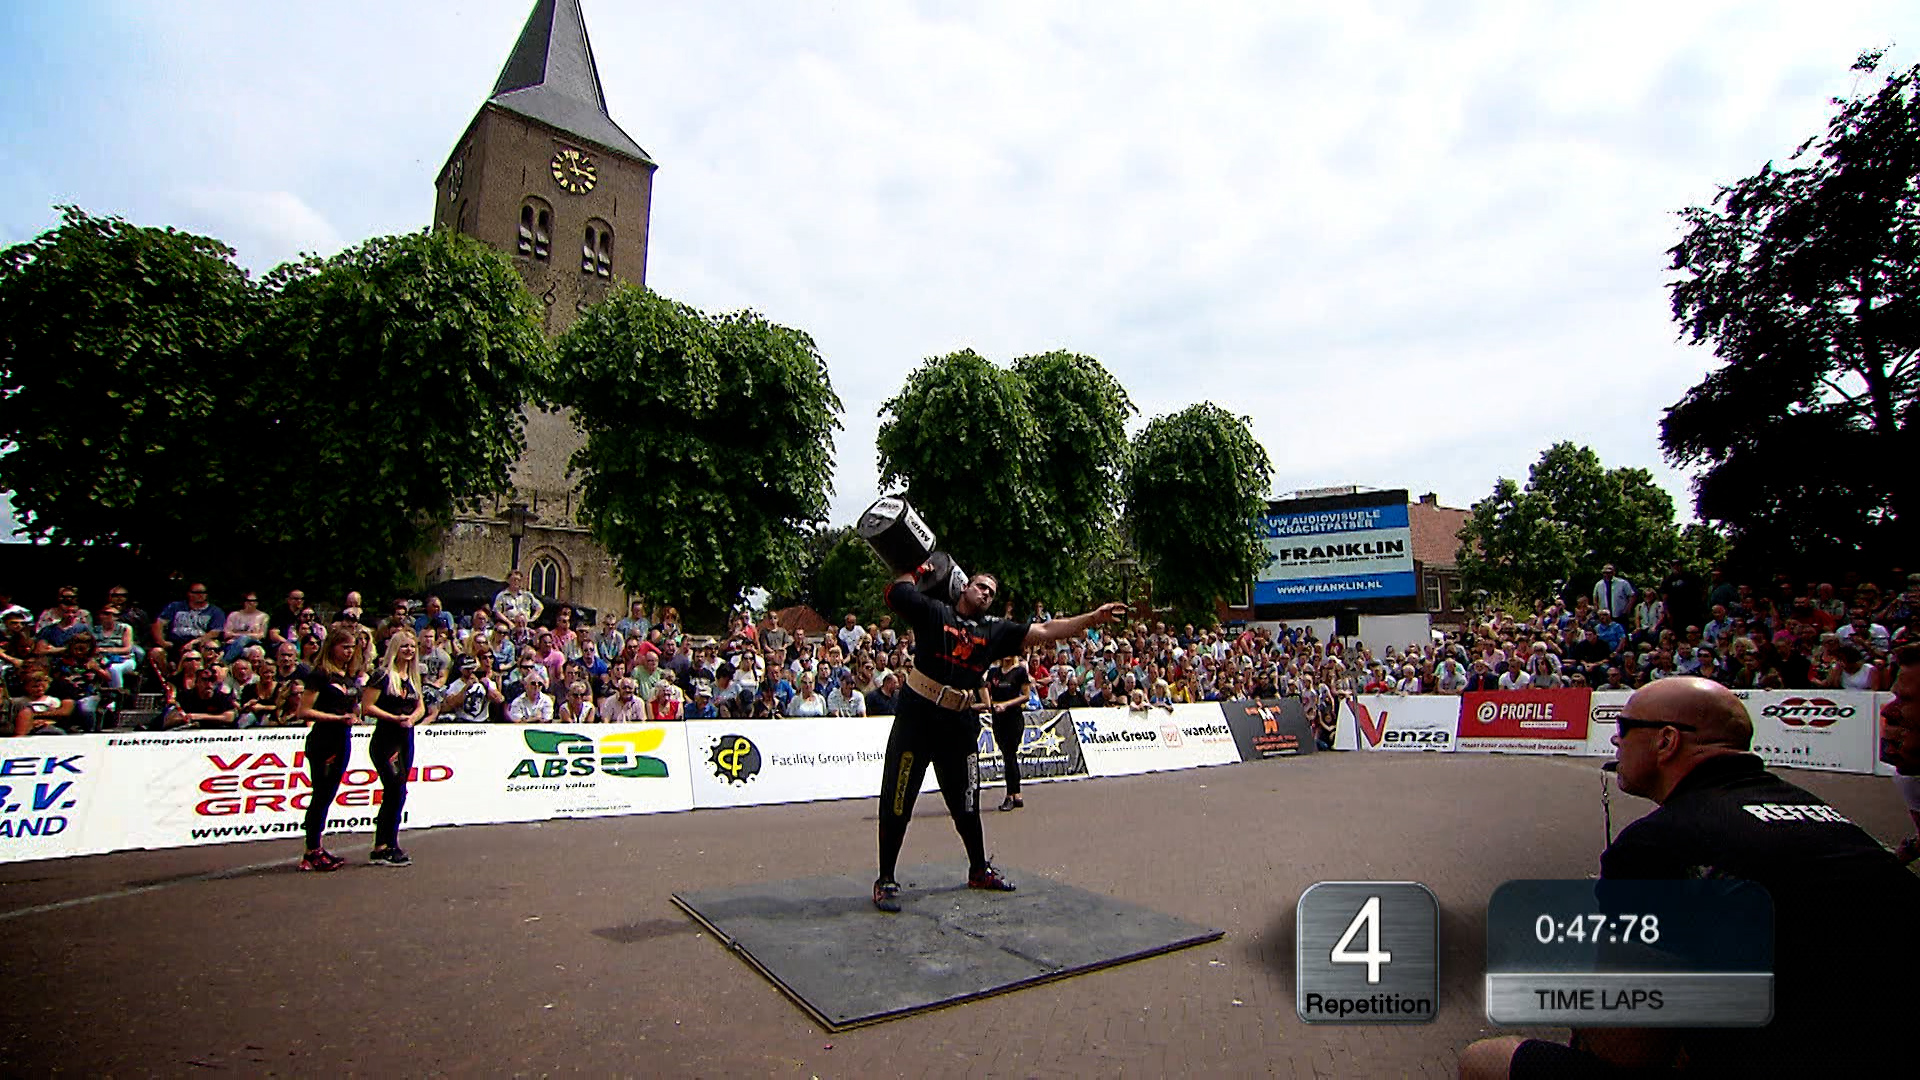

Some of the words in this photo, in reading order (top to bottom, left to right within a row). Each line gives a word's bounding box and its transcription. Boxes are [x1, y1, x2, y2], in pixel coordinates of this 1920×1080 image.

[1269, 517, 1288, 528] UW
[1293, 509, 1381, 526] AUDIOVISUELE
[1277, 519, 1373, 535] KRACHTPATSER
[1279, 539, 1404, 561] FRANKLIN
[1277, 580, 1383, 595] WWW.FRANKLIN.NL
[1500, 703, 1554, 720] PROFILE
[1181, 724, 1229, 737] wanders
[1346, 699, 1450, 748] Venza
[1121, 730, 1157, 742] Group
[771, 752, 815, 766] Facility
[818, 752, 854, 766] Group
[507, 757, 596, 779] ABS
